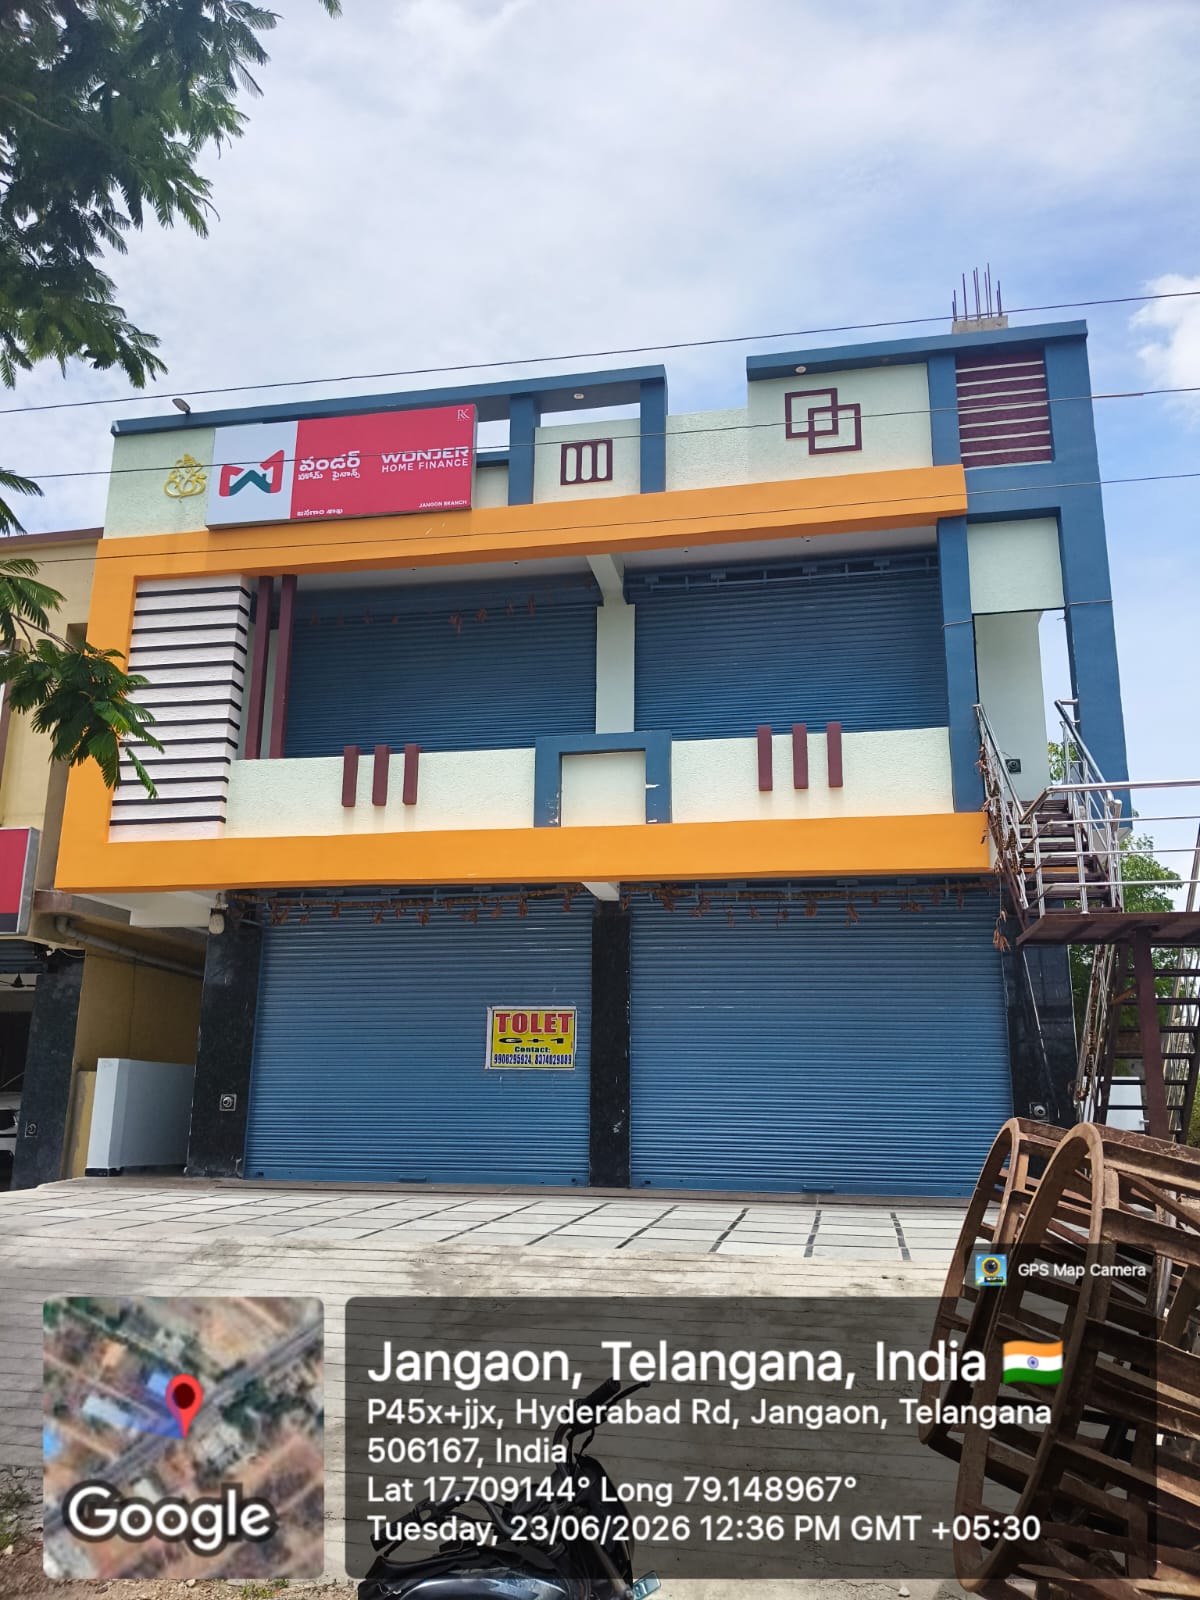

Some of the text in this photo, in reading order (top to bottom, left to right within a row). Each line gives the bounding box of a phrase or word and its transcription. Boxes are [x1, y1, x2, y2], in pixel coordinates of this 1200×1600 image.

[299, 450, 360, 471] వండర్
[381, 446, 469, 464] WONDER
[381, 458, 469, 473] HOME FINANCE
